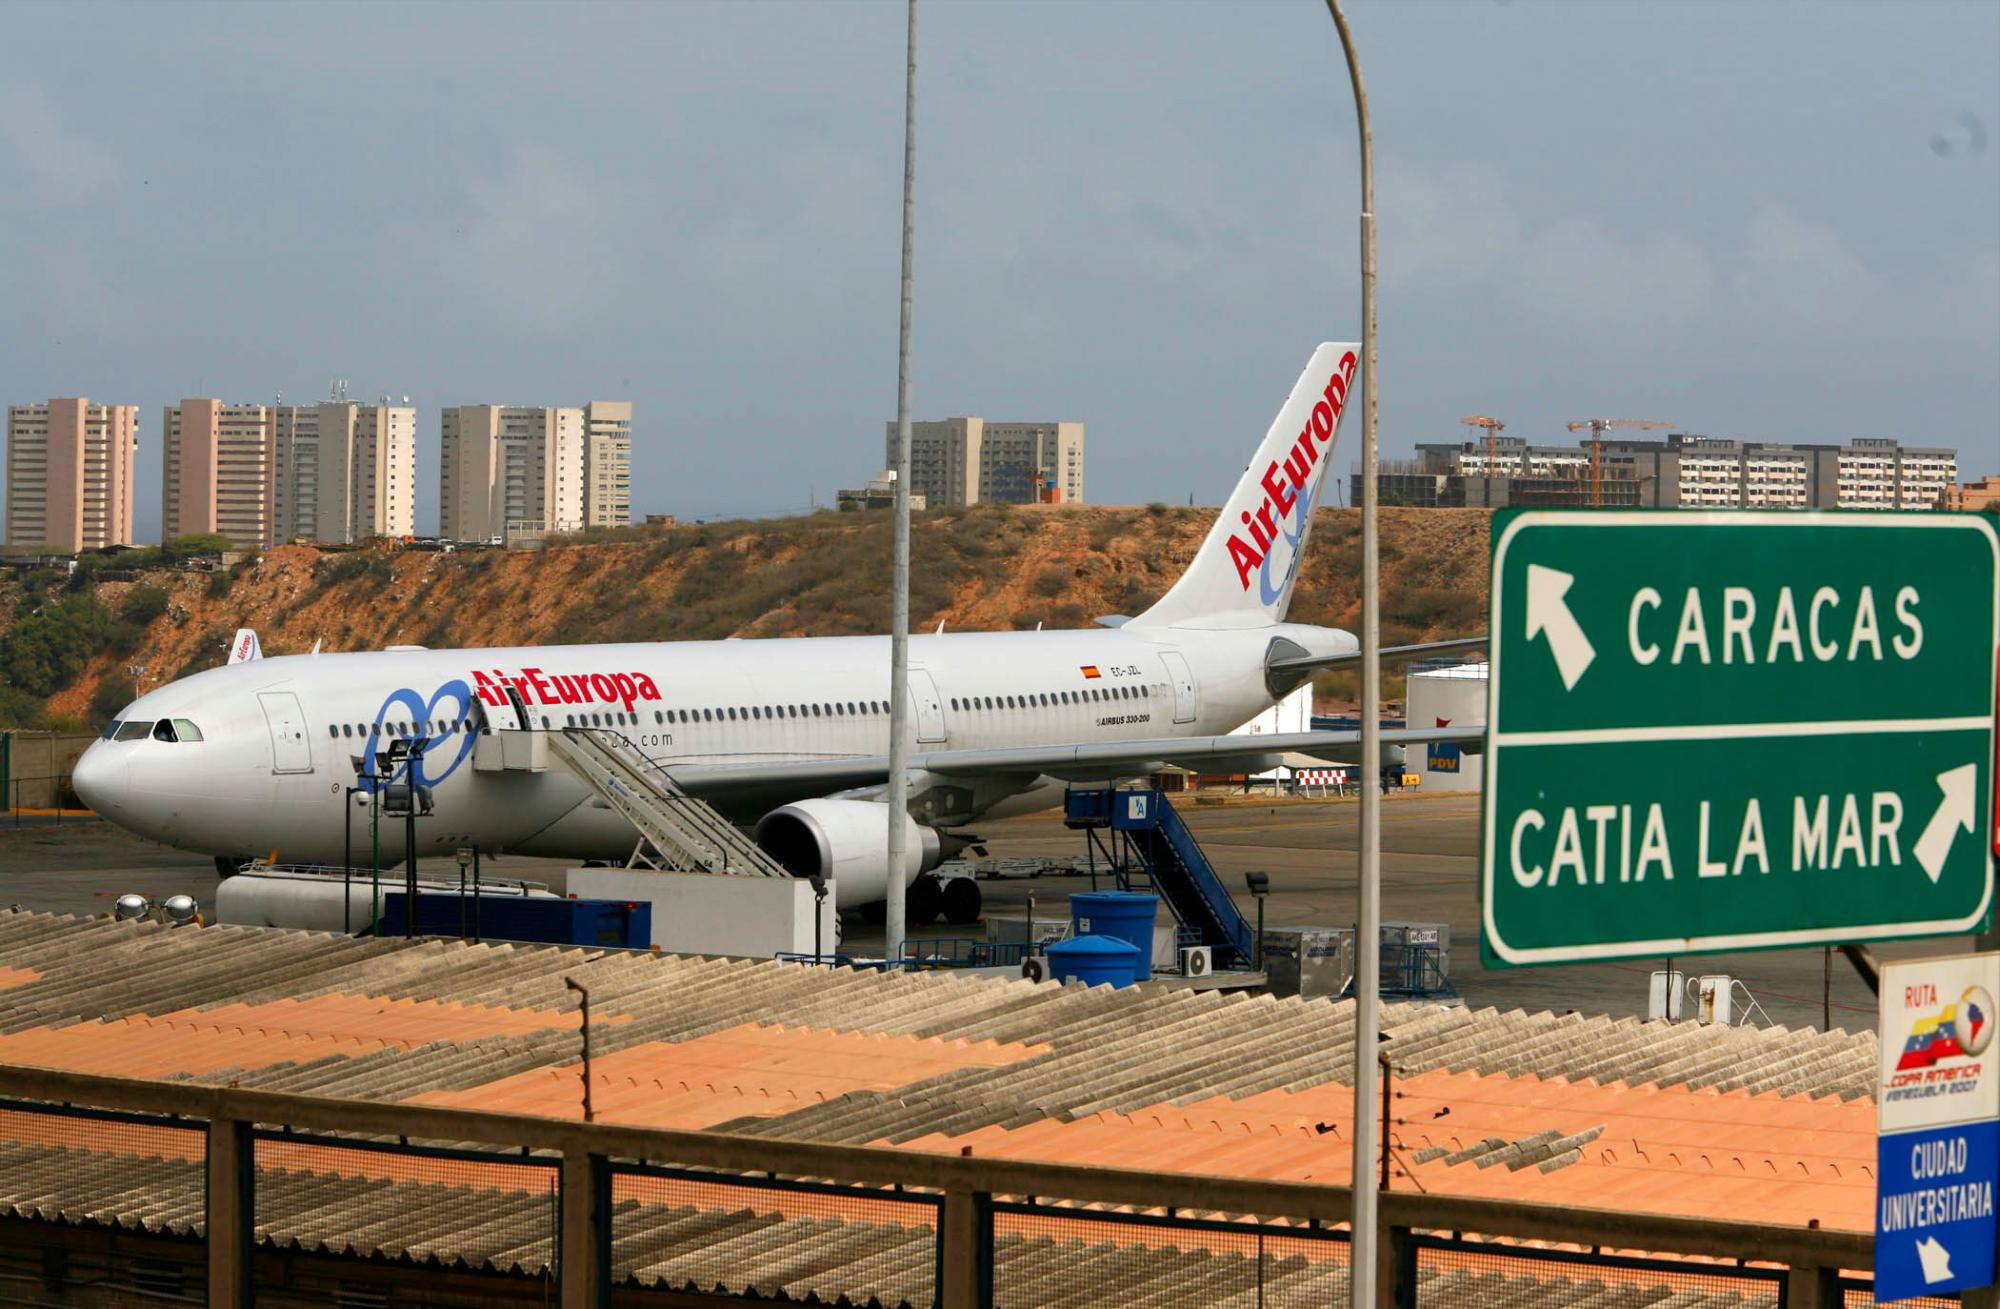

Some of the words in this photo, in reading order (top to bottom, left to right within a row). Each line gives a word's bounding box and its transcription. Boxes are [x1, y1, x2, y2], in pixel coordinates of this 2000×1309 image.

[1628, 585, 1924, 665] CARACAS
[471, 668, 662, 712] AirEuropa
[1100, 715, 1125, 726] AIRBUS
[1125, 714, 1151, 724] 330-200
[1429, 757, 1456, 769] PDV
[1510, 802, 1675, 888] CATIA
[1698, 797, 1770, 879] LA
[1792, 791, 1904, 872] MAR
[1905, 984, 1938, 1008] RUTA
[1890, 1072, 1924, 1088] COPA
[1911, 1136, 1967, 1180] CIUDAD
[1882, 1181, 1992, 1233] UNIVERSITARIA
